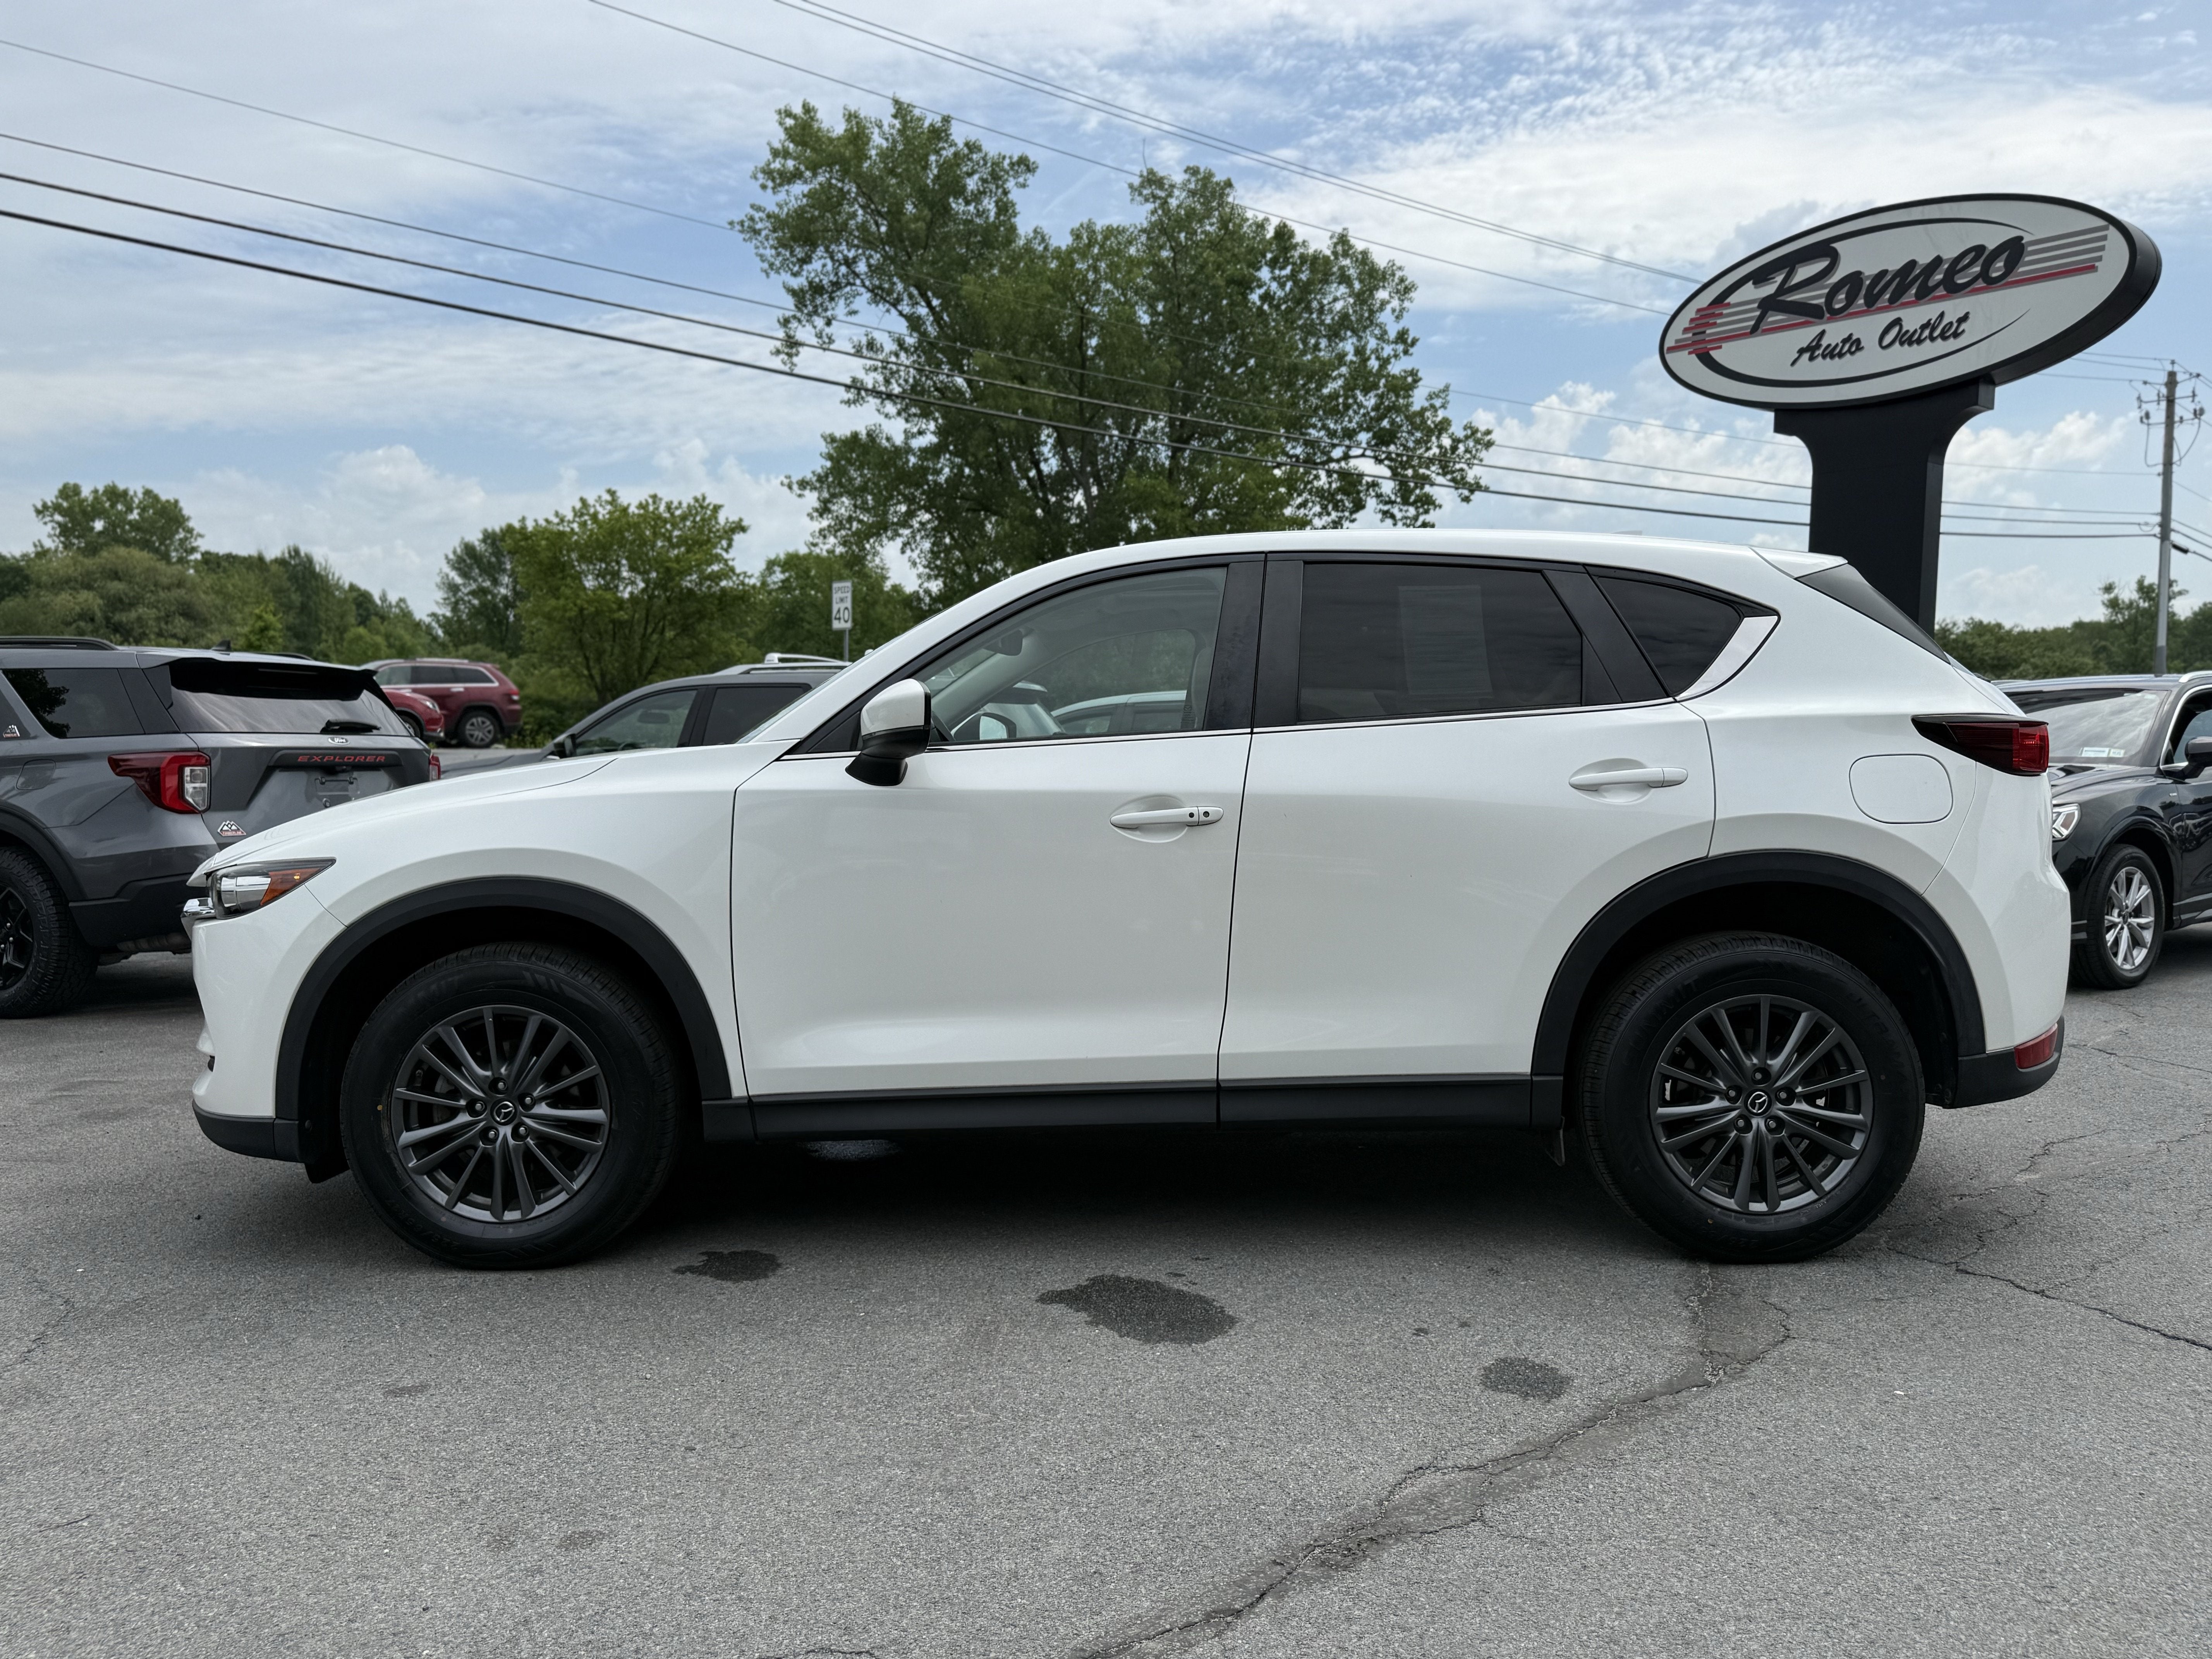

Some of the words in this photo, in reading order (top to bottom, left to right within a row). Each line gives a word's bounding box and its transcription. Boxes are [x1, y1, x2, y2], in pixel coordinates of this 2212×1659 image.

[1750, 235, 2026, 335] Romeo
[1790, 329, 1865, 367] Auto
[1878, 310, 1970, 350] Outlet
[834, 586, 850, 594] SPEED
[835, 596, 848, 604] LIMIT
[834, 606, 850, 624] 40
